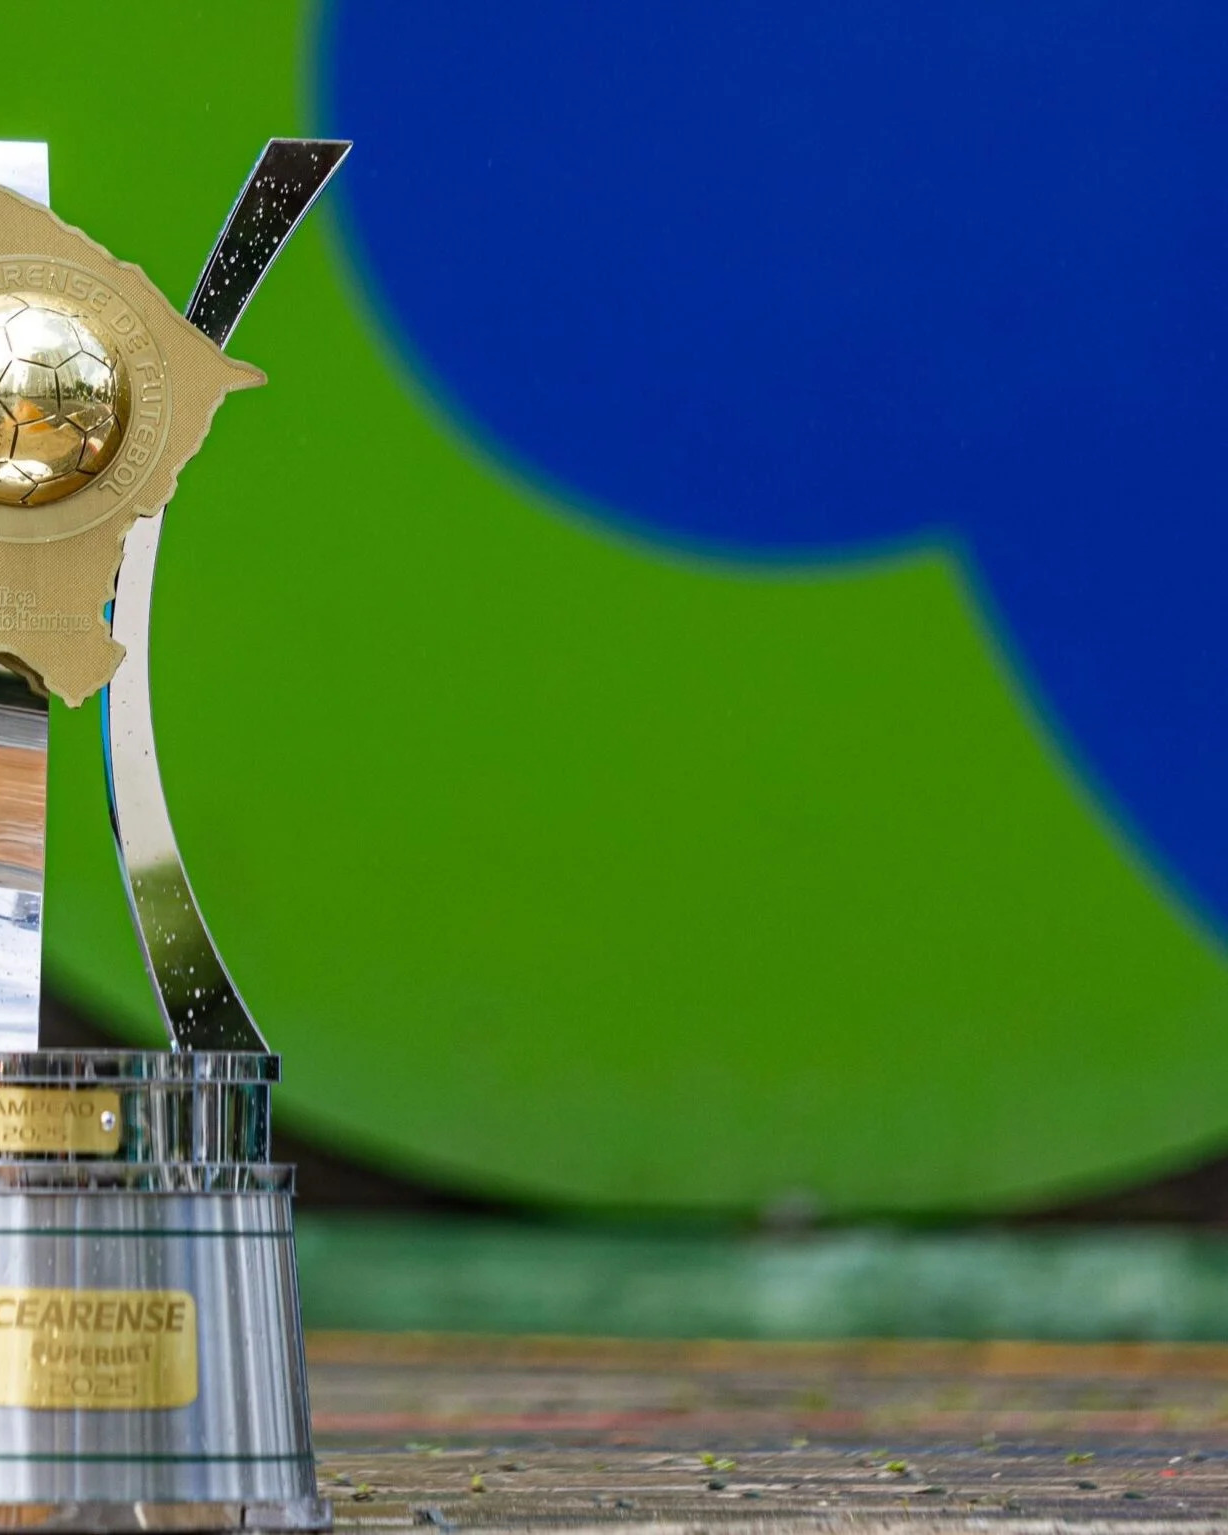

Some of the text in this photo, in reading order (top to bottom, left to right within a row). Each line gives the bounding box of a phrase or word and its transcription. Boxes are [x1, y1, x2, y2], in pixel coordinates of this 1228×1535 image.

[115, 313, 148, 355] DE
[99, 363, 161, 496] FUTEBOL
[18, 611, 92, 632] Henrique
[49, 1372, 137, 1398] 2025
